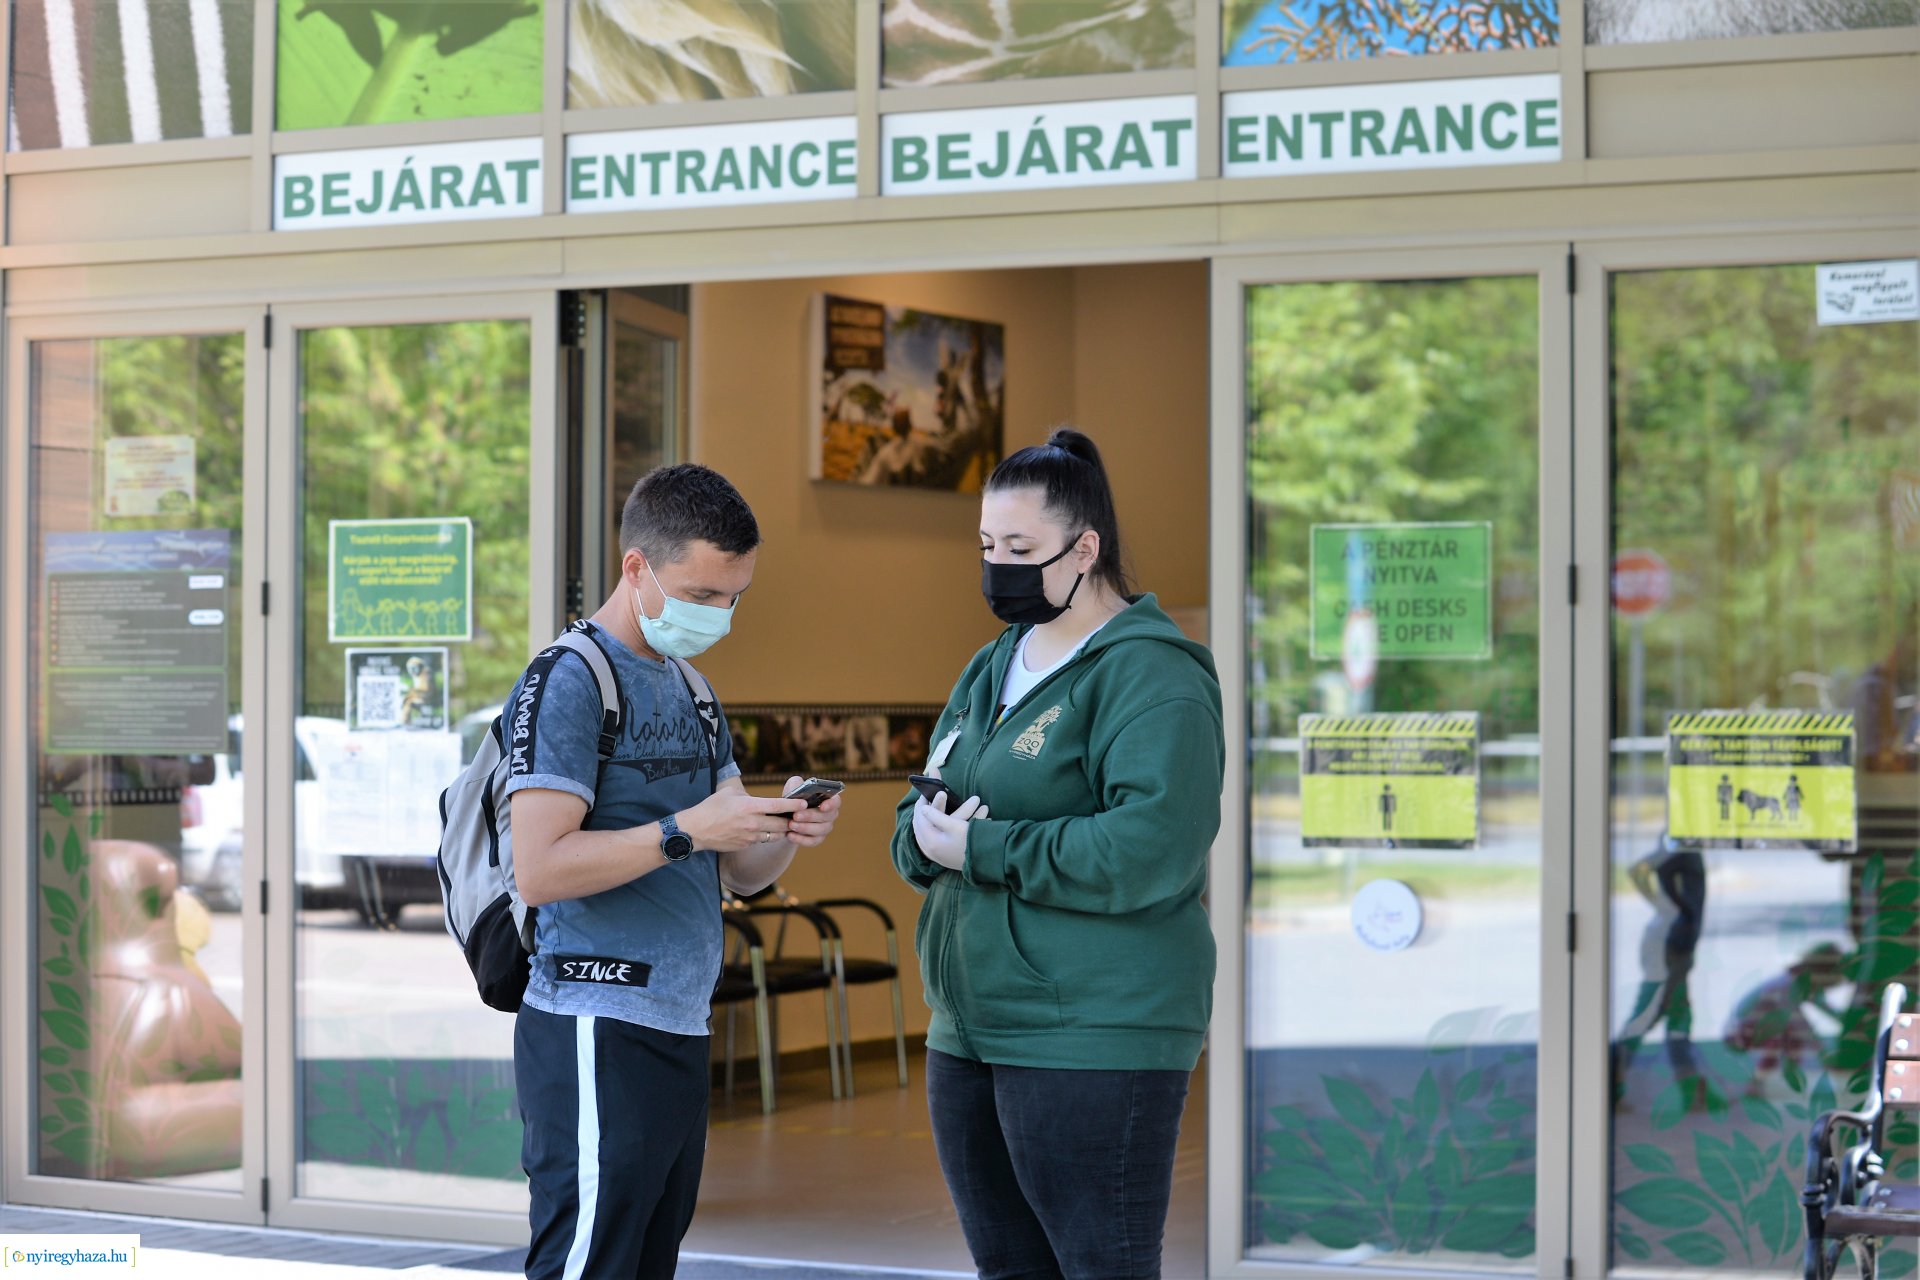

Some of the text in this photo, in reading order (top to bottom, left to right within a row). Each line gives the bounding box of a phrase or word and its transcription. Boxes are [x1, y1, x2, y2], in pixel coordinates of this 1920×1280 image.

[1227, 99, 1559, 164] ENTRANCE
[891, 115, 1193, 184] BEJÁRAT
[570, 139, 857, 200] ENTRANCE
[282, 156, 540, 218] BEJÁRAT
[1362, 535, 1458, 560] PÉNZTÁR
[1364, 566, 1438, 585] NYITVA
[1397, 598, 1467, 618] DESKS
[1395, 624, 1454, 643] OPEN
[512, 674, 541, 743] BRAND
[1017, 737, 1040, 748] ZOO
[562, 961, 632, 982] SINCE
